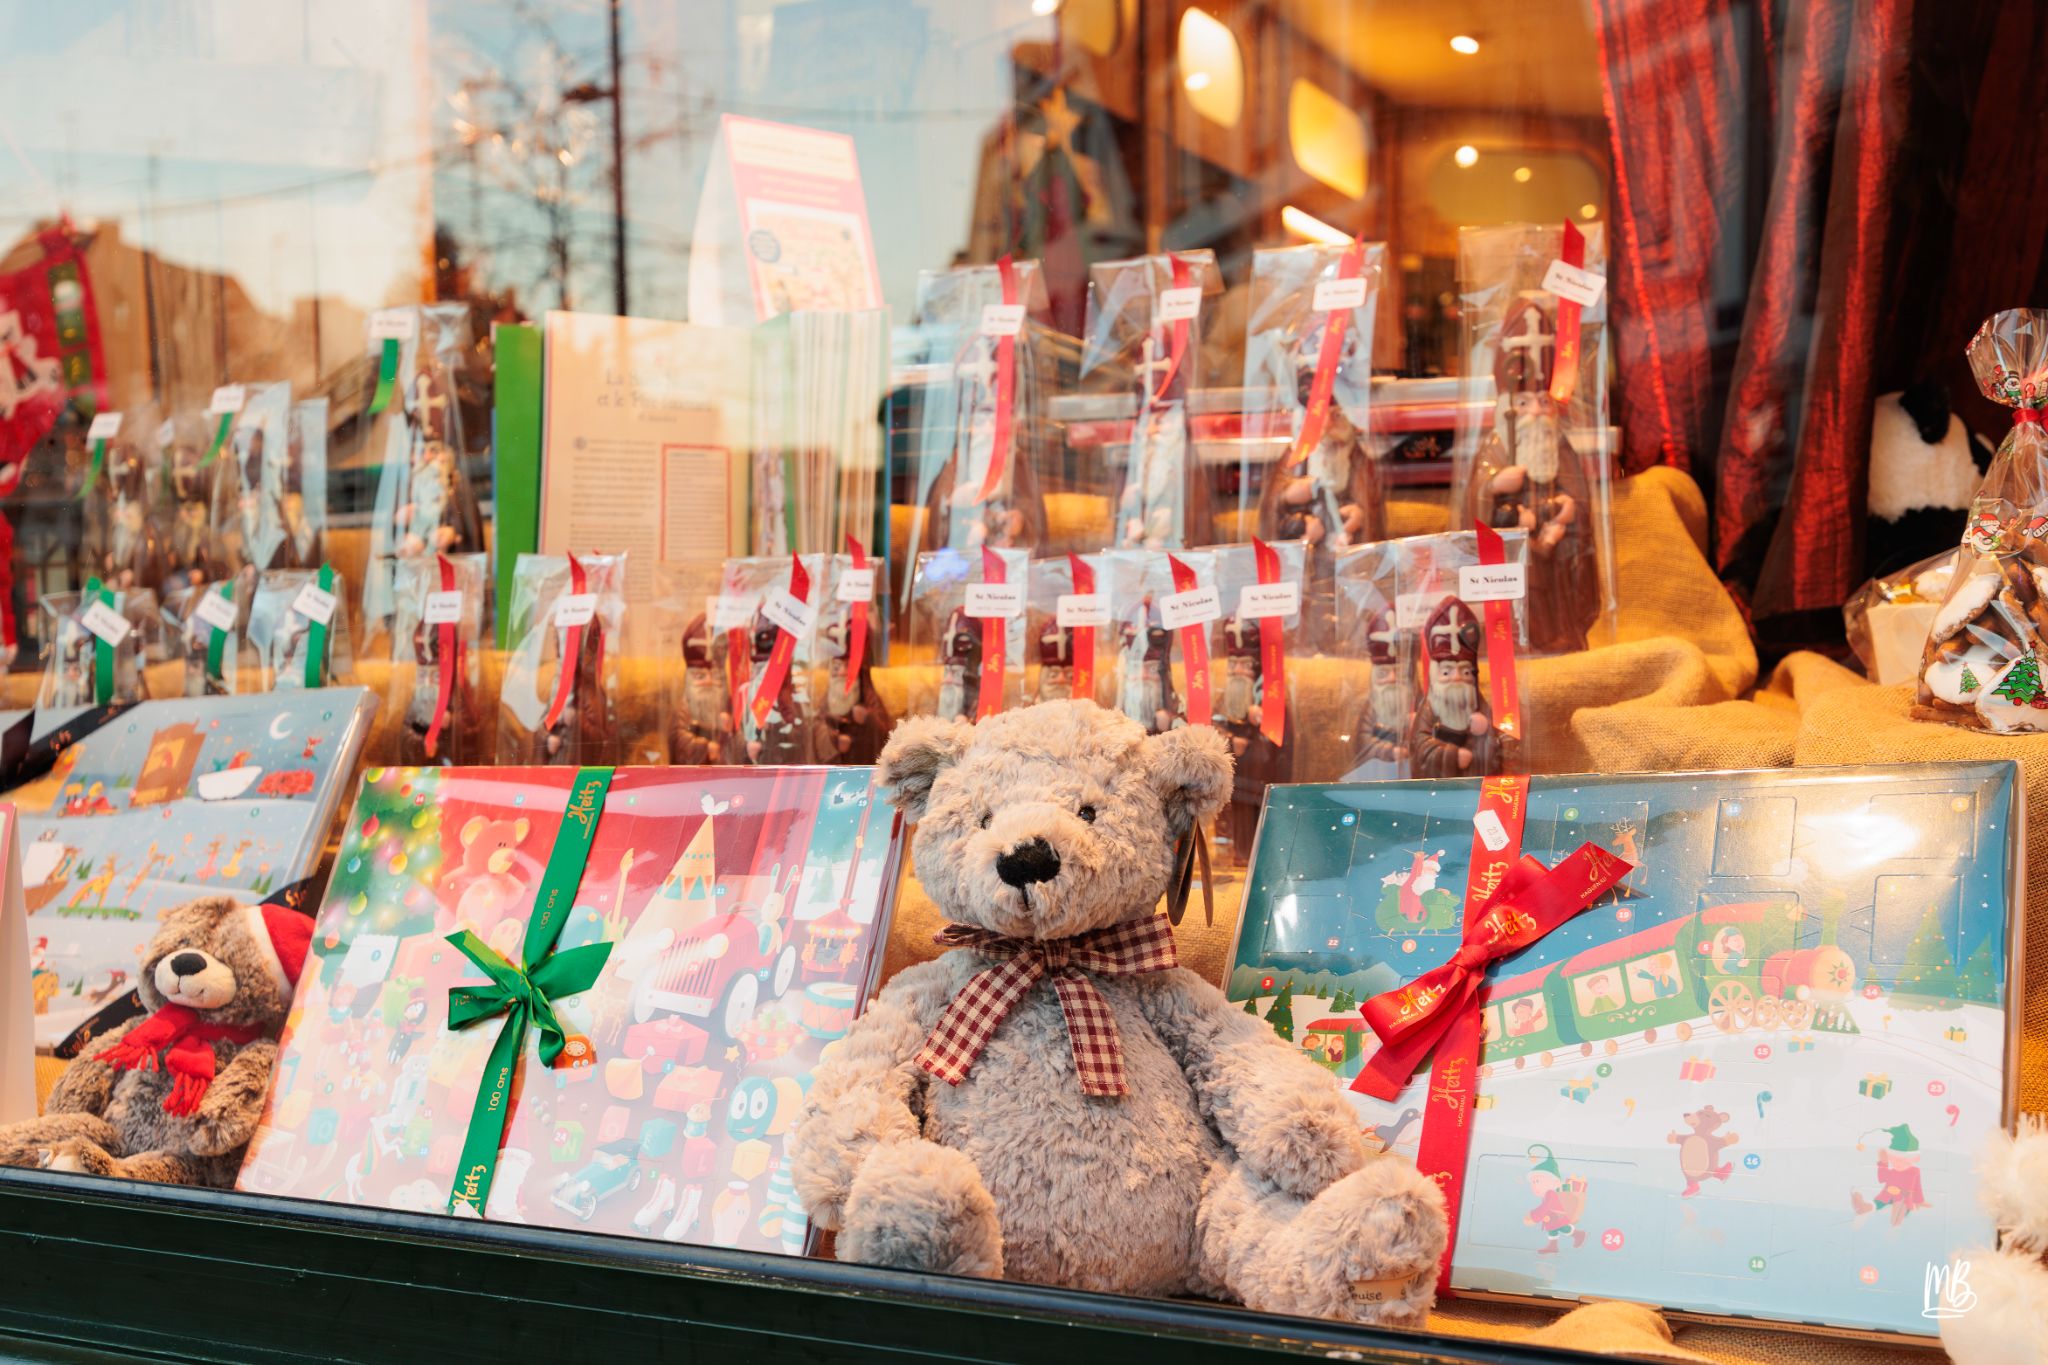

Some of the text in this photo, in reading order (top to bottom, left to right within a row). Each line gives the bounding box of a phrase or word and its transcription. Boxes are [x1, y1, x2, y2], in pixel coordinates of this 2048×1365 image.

[1483, 575, 1518, 583] Nicolas
[1183, 596, 1213, 608] Nicolas
[567, 781, 602, 824] Heitz
[1472, 861, 1509, 901] Heitz
[1484, 912, 1537, 944] Heitz
[1397, 983, 1447, 1015] Heitz
[488, 1067, 509, 1112] 100 ans
[1432, 1057, 1468, 1110] Heitz
[1604, 1233, 1621, 1247] 24
